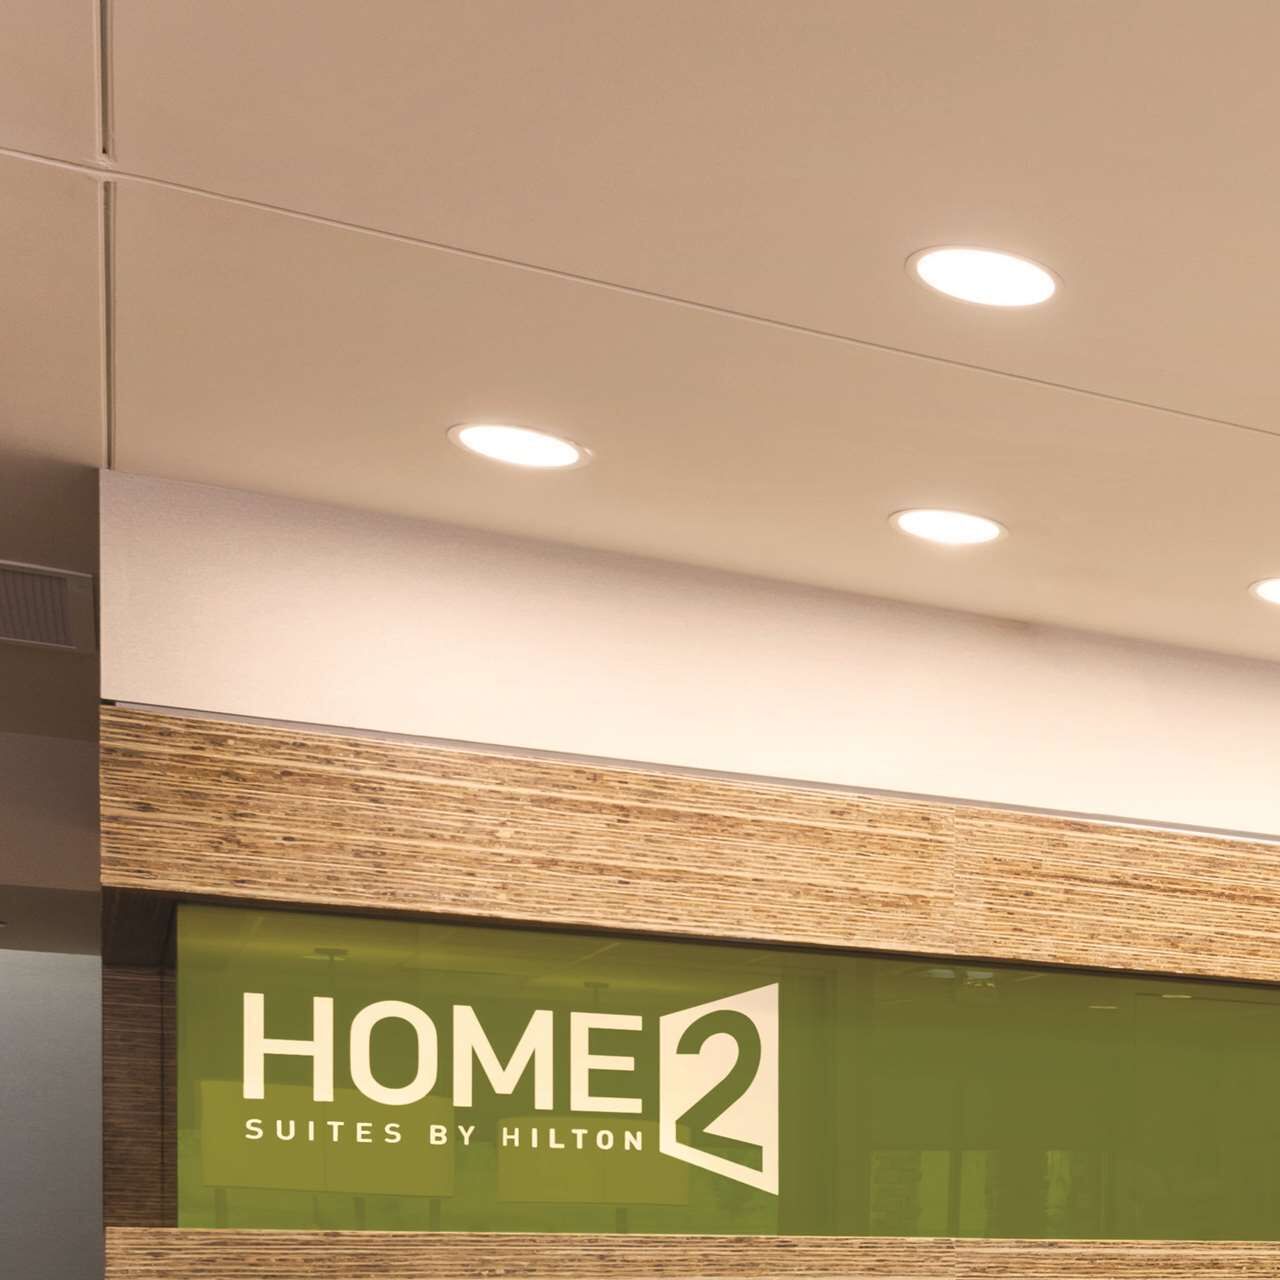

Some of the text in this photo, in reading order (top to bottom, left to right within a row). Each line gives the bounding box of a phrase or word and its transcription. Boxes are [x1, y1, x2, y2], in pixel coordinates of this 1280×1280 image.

[243, 992, 644, 1114] HOME
[245, 1118, 644, 1151] SUITES BY HILTON
